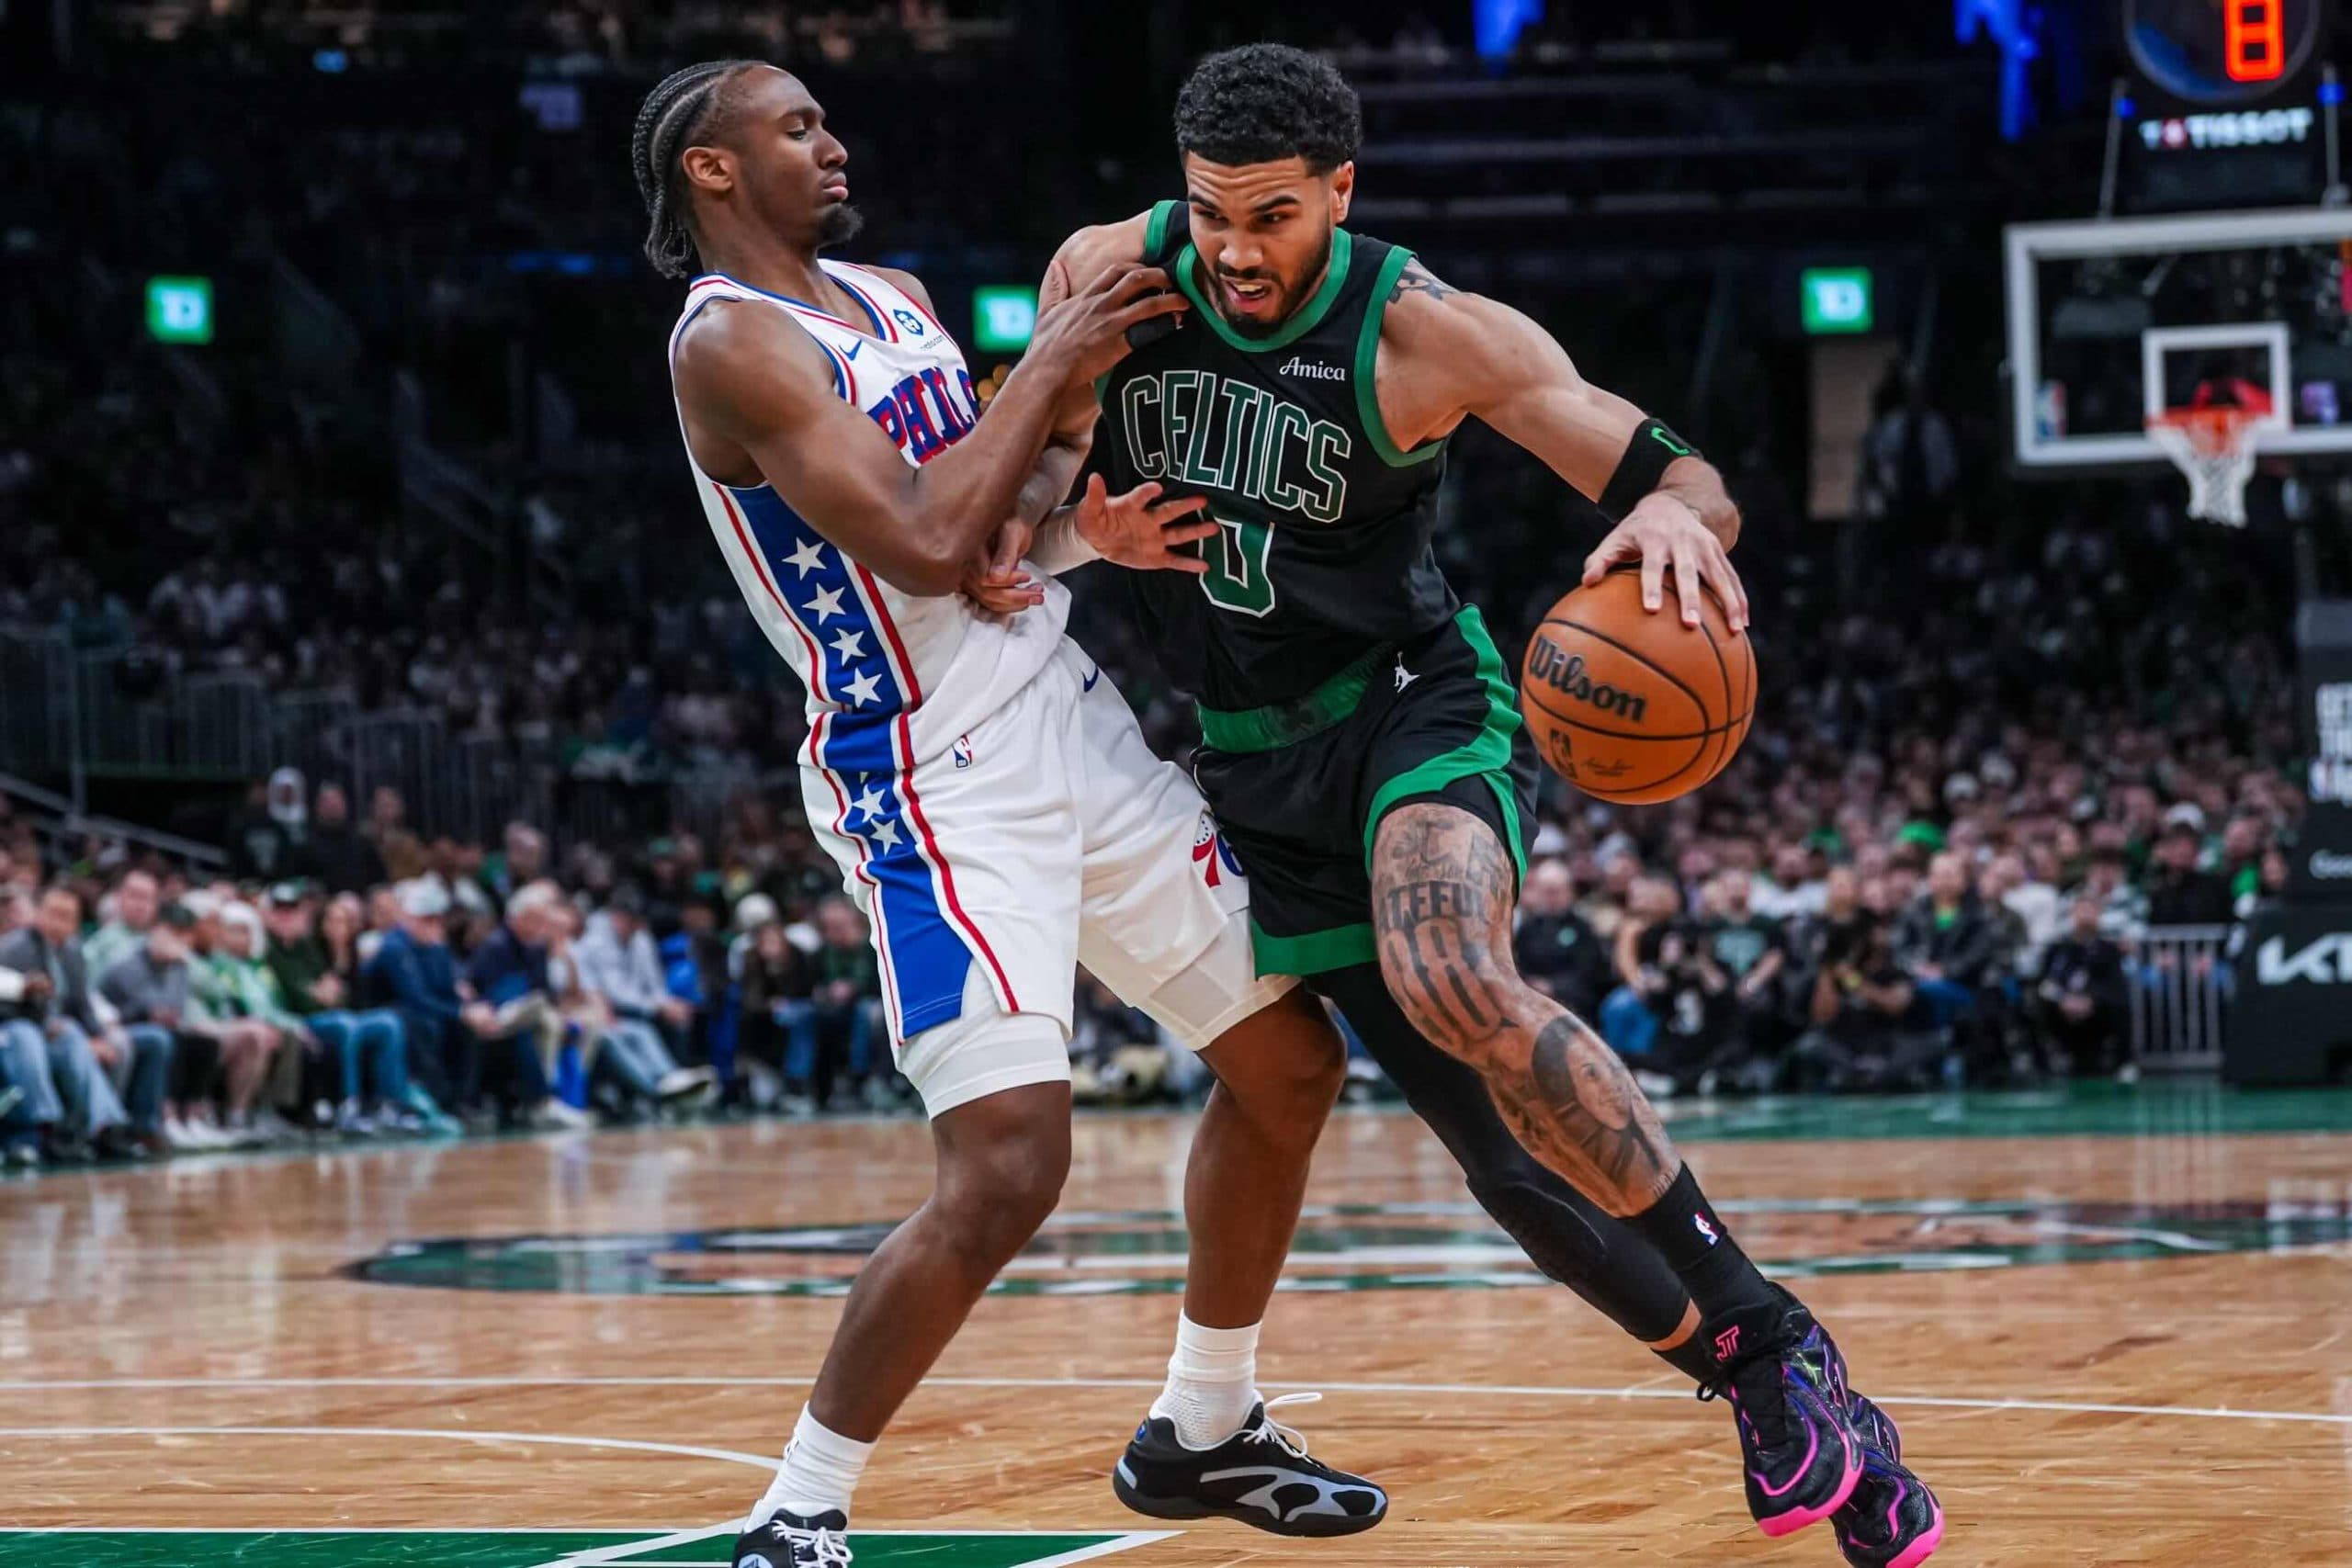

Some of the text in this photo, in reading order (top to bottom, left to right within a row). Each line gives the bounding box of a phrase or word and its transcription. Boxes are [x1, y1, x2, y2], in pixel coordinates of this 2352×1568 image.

[1280, 356, 1346, 381] Amica
[1122, 370, 1351, 523] CELTICS
[1198, 509, 1276, 618] 0
[1529, 634, 1647, 723] Wilson
